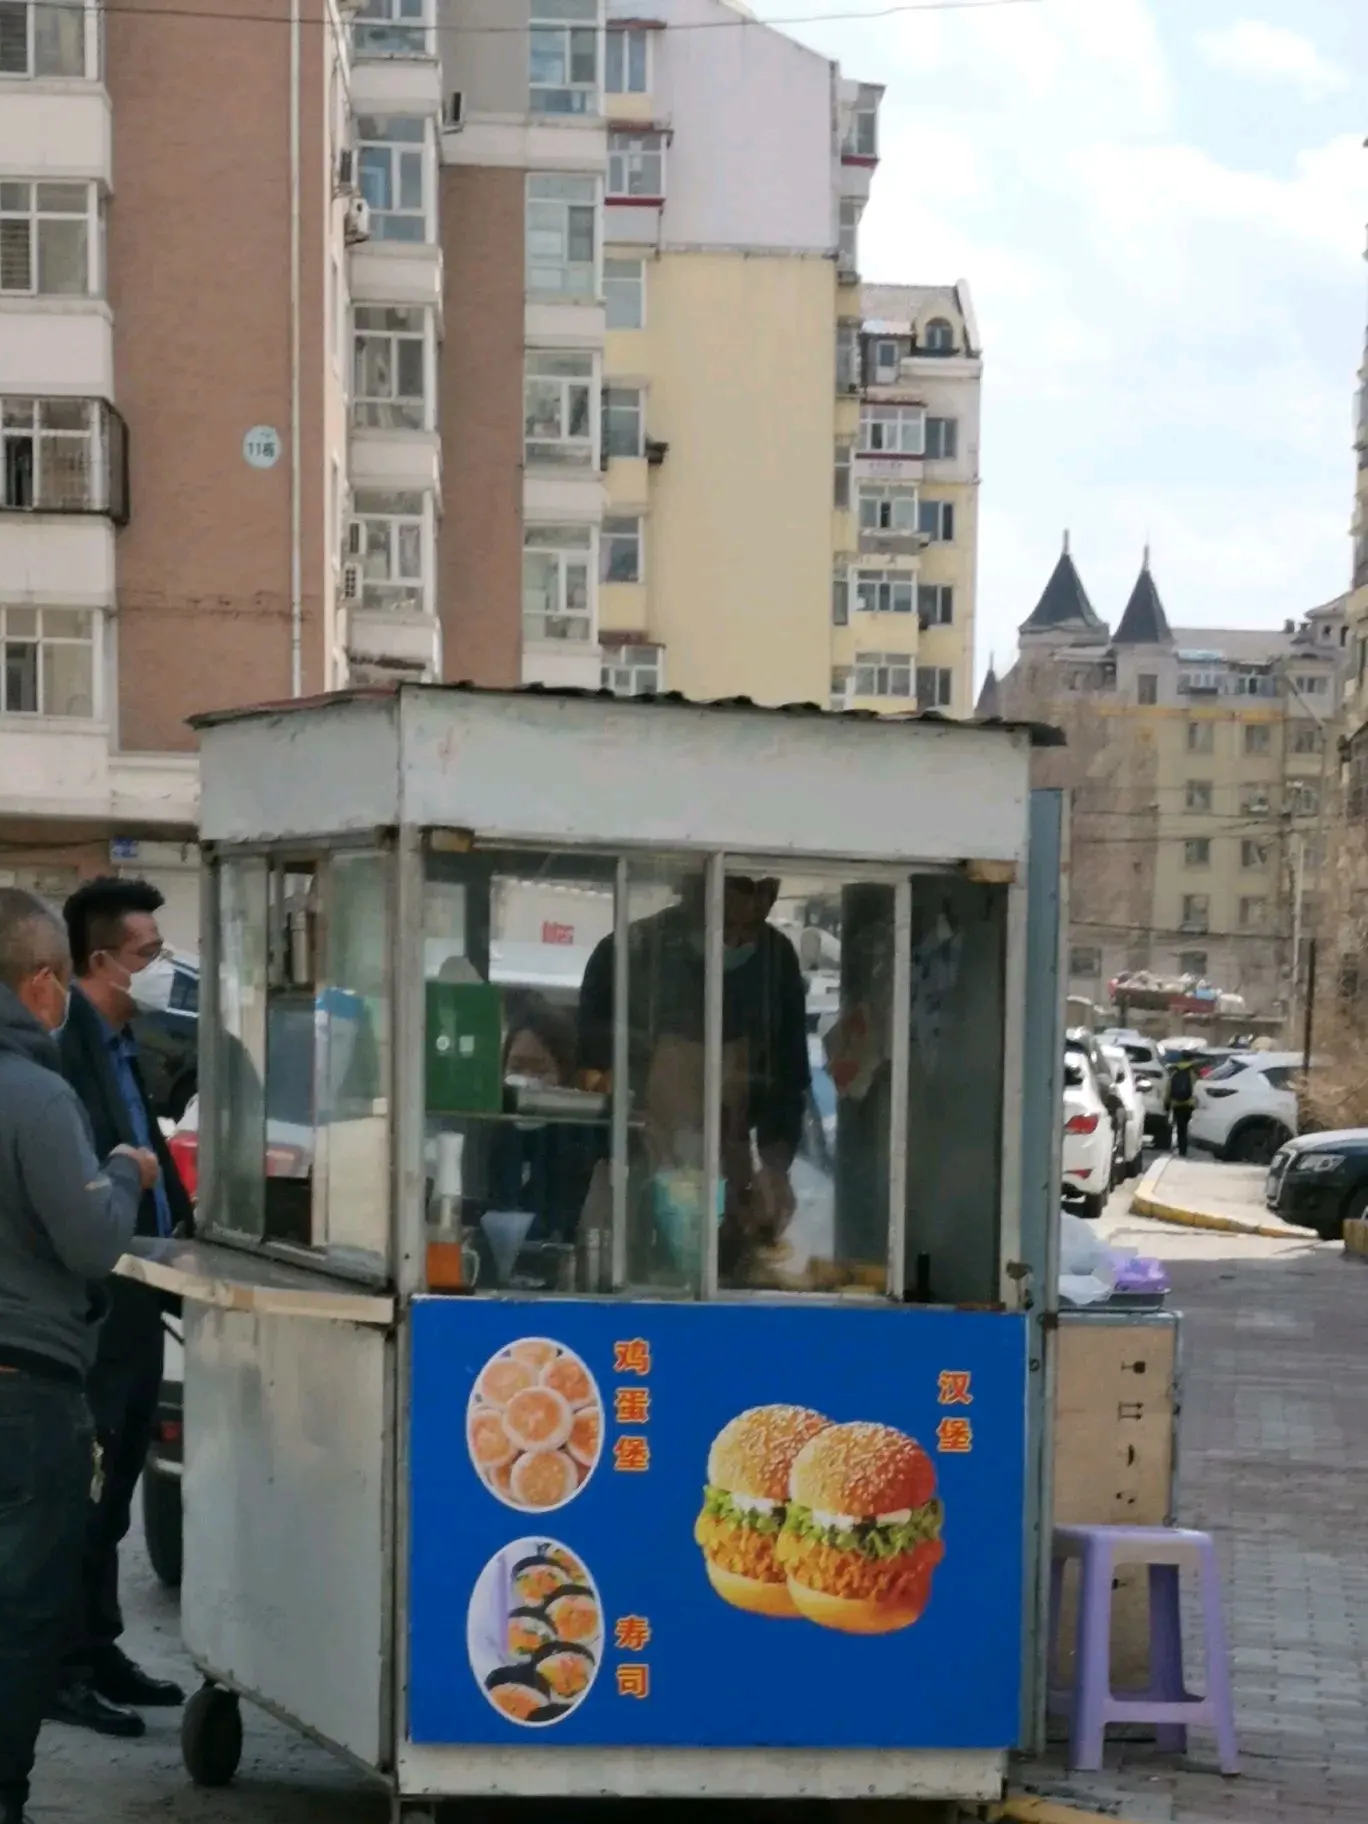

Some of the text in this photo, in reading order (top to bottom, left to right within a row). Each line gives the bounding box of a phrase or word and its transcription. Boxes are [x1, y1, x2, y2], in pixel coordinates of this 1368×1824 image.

[613, 1336, 652, 1472] 鸡蛋堡
[936, 1369, 974, 1453] 汉堡
[615, 1613, 652, 1699] 寿司
